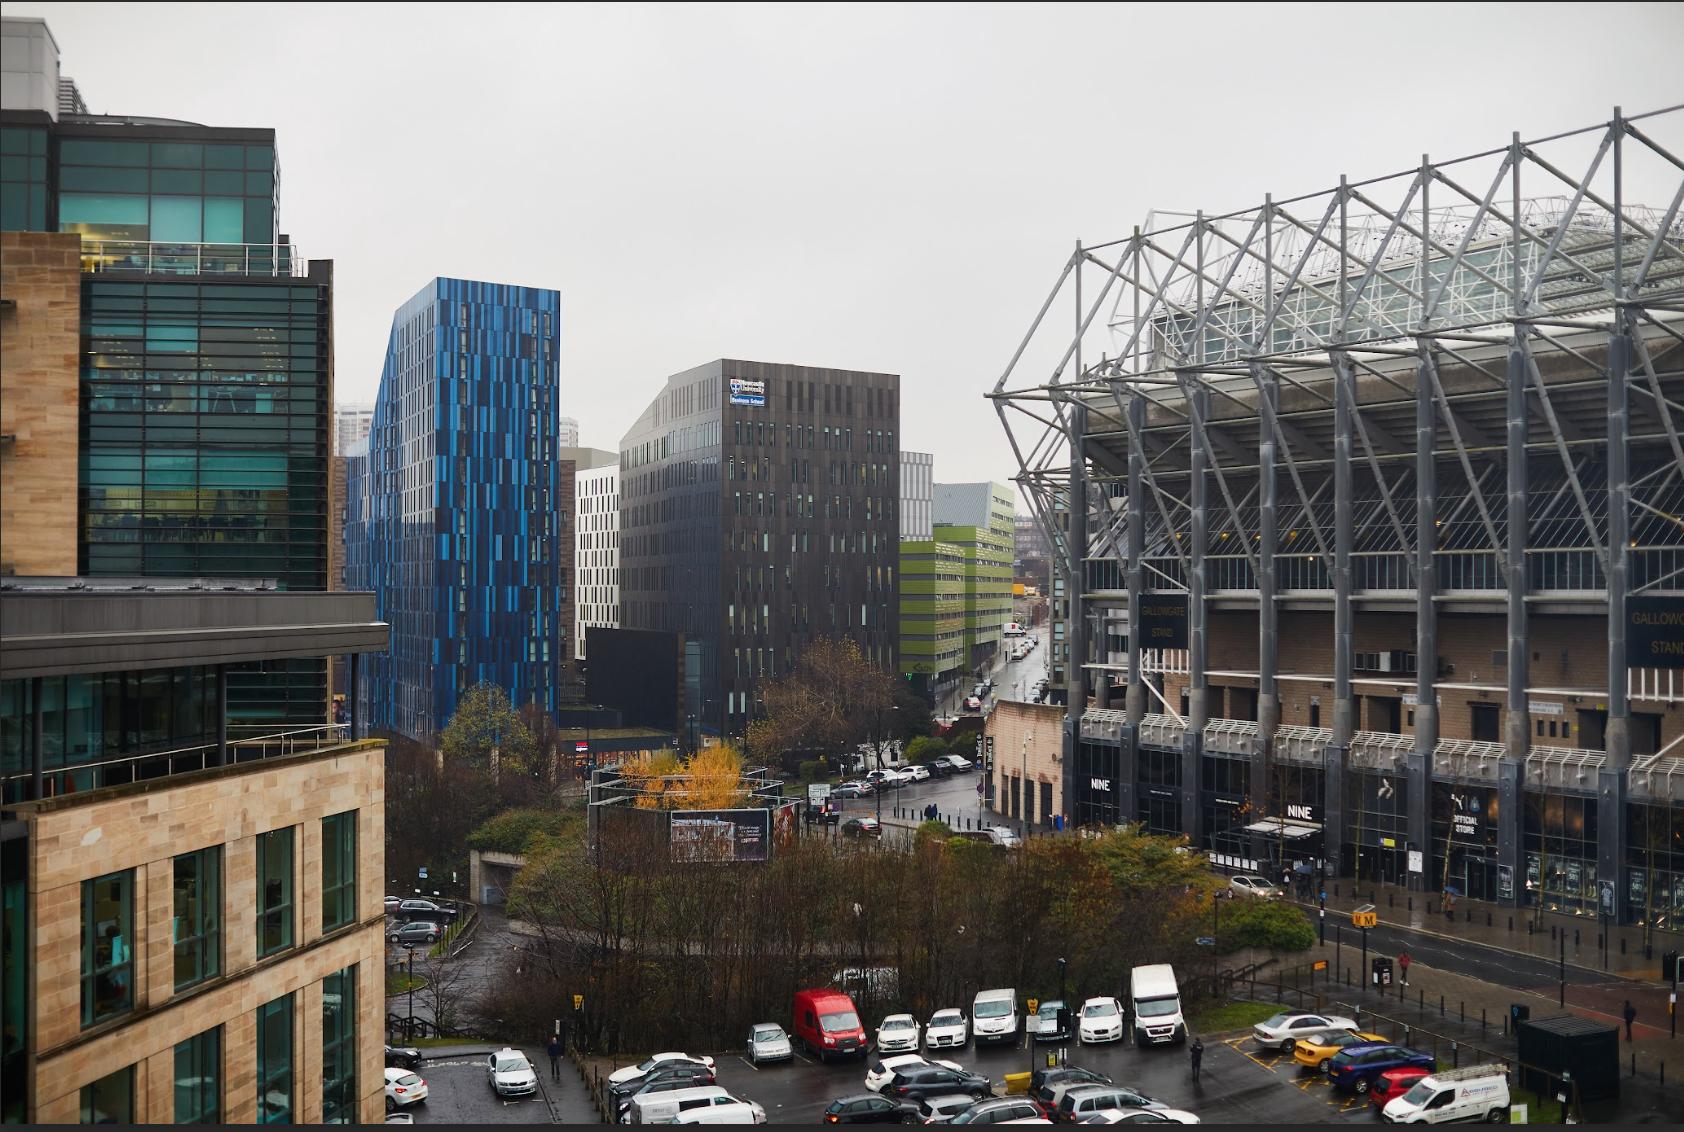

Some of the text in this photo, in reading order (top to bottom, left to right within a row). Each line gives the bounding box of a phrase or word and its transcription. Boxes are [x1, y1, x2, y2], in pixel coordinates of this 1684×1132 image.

[1091, 777, 1110, 791] NINE
[1287, 804, 1312, 820] NINE
[1453, 814, 1478, 825] OFFICIAL
[1455, 824, 1475, 834] STORE
[1364, 915, 1374, 926] M
